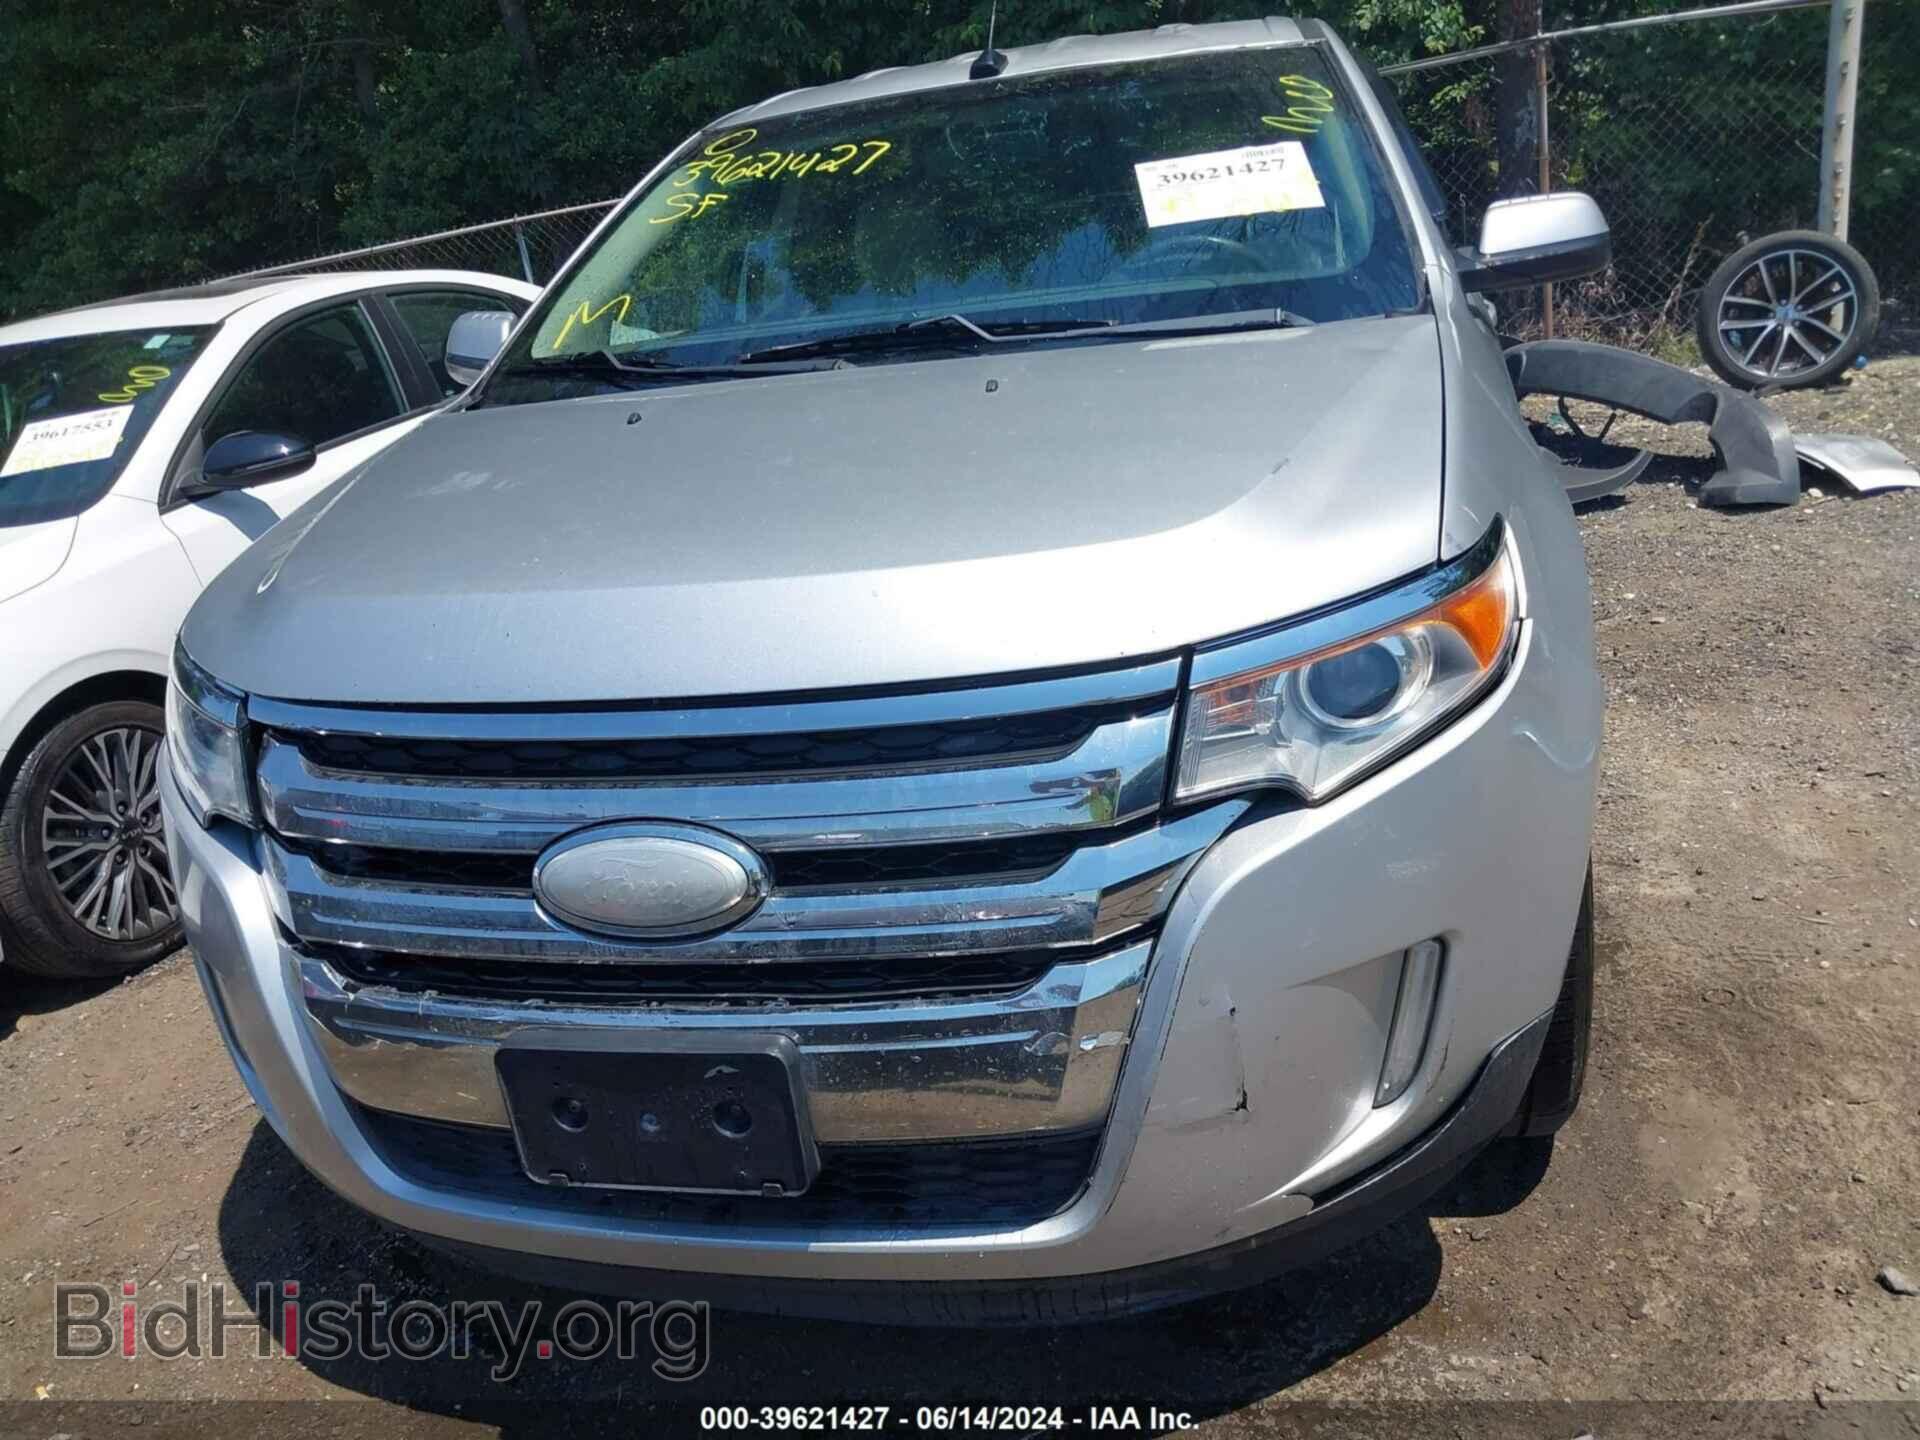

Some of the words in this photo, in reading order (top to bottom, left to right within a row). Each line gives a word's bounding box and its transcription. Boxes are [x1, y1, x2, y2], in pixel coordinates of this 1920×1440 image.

[673, 141, 891, 187] 39621427
[1158, 158, 1285, 187] 39621427
[648, 192, 729, 225] SF
